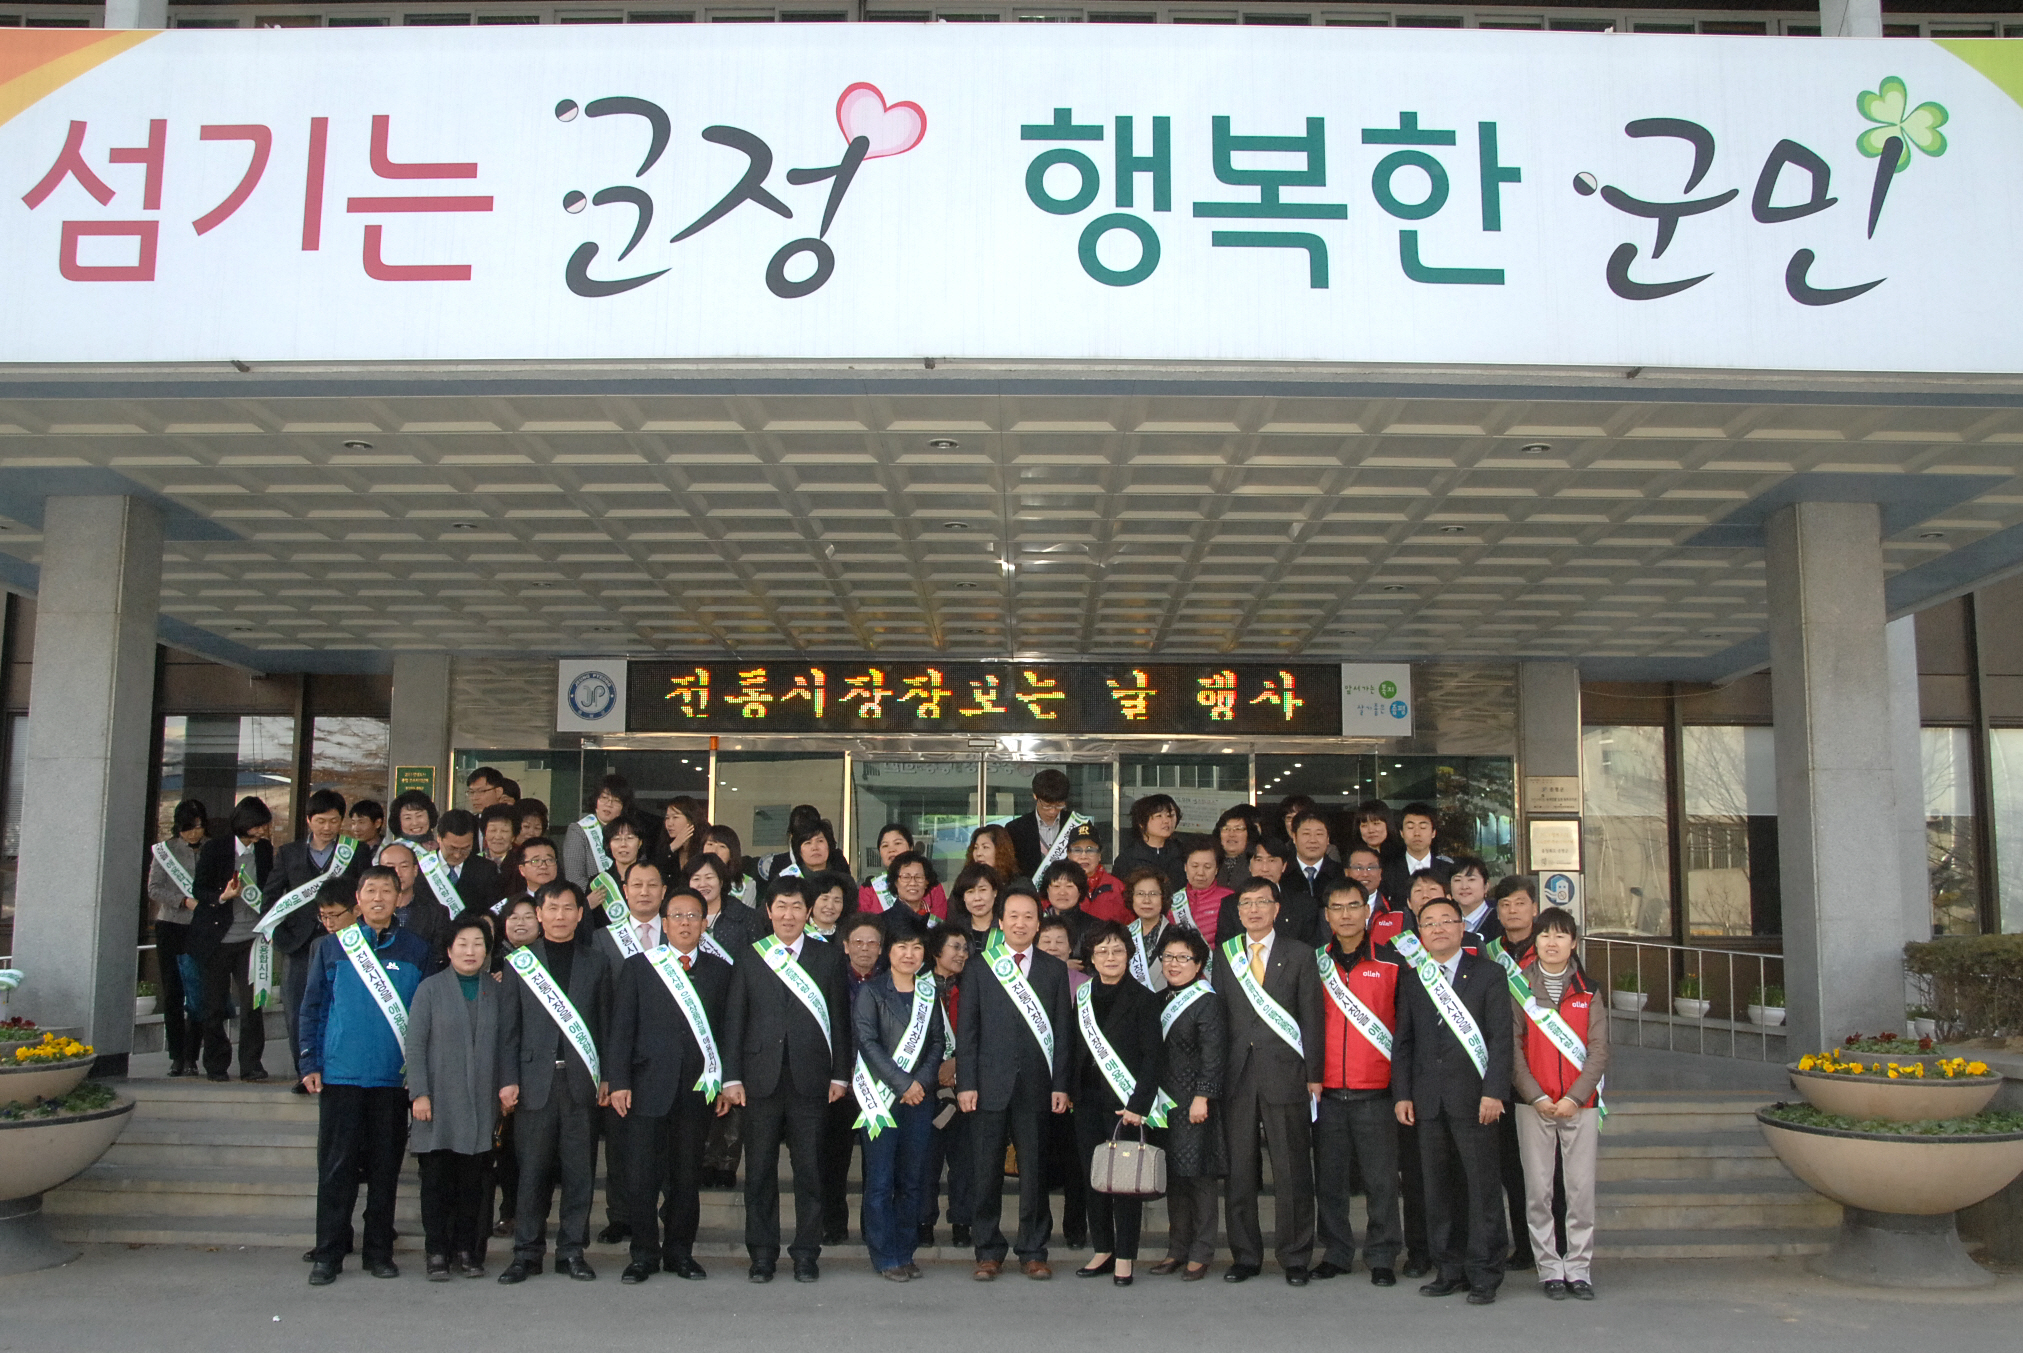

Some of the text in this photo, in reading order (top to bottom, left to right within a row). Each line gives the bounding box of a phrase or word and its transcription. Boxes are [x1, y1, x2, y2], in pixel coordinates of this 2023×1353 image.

[20, 96, 1905, 307] 섬기는 군정 행복한 군민
[1106, 669, 1158, 721] 날
[1197, 669, 1305, 722] 행사
[1381, 683, 1395, 697] 복지
[1378, 919, 1394, 927] olleh
[356, 950, 394, 1003] 전통시장을
[531, 972, 574, 1023] 전통시장을
[1362, 970, 1381, 978] olleh
[1011, 981, 1048, 1035] 전통시장을
[1329, 977, 1371, 1027] 전통시장을
[1433, 982, 1473, 1036] 전통시장을
[903, 1002, 929, 1056] 전통시장을
[1081, 1007, 1110, 1060] 전통시장을
[855, 1072, 879, 1110] 애용합시다
